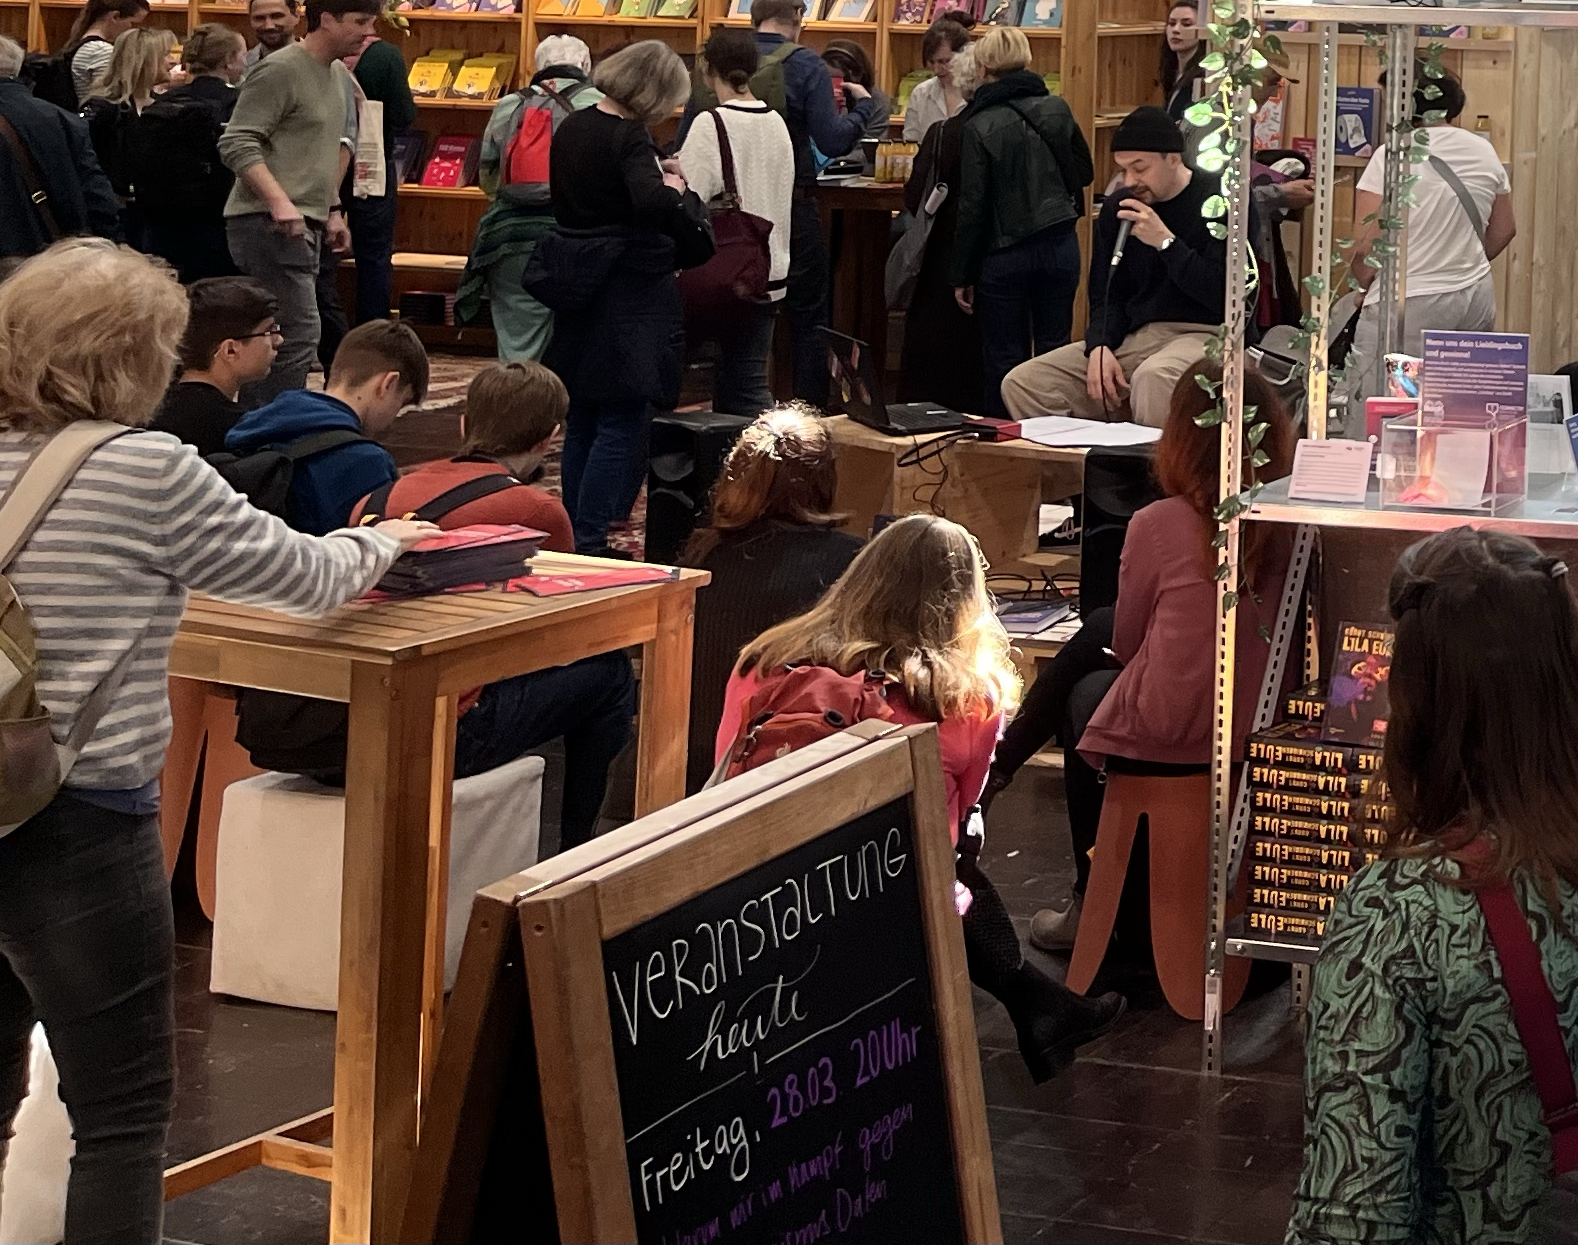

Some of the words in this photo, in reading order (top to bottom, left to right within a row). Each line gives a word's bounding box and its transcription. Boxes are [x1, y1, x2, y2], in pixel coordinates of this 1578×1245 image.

[1342, 639, 1369, 654] LILA
[1287, 699, 1321, 718] EULE
[1249, 742, 1283, 761] EULE
[1314, 750, 1343, 769] LILA
[1252, 766, 1286, 785] EULE
[1317, 775, 1347, 793] LILA
[1255, 791, 1289, 811] EULE
[1320, 799, 1350, 818] LILA
[1254, 816, 1287, 835] EULE
[1318, 823, 1348, 842] LILA
[1255, 841, 1289, 860] EULE
[1320, 848, 1351, 867] LILA
[1254, 865, 1287, 884] EULE
[1253, 888, 1286, 907] EULE
[1317, 895, 1335, 911] LA
[1250, 912, 1284, 932] EULE
